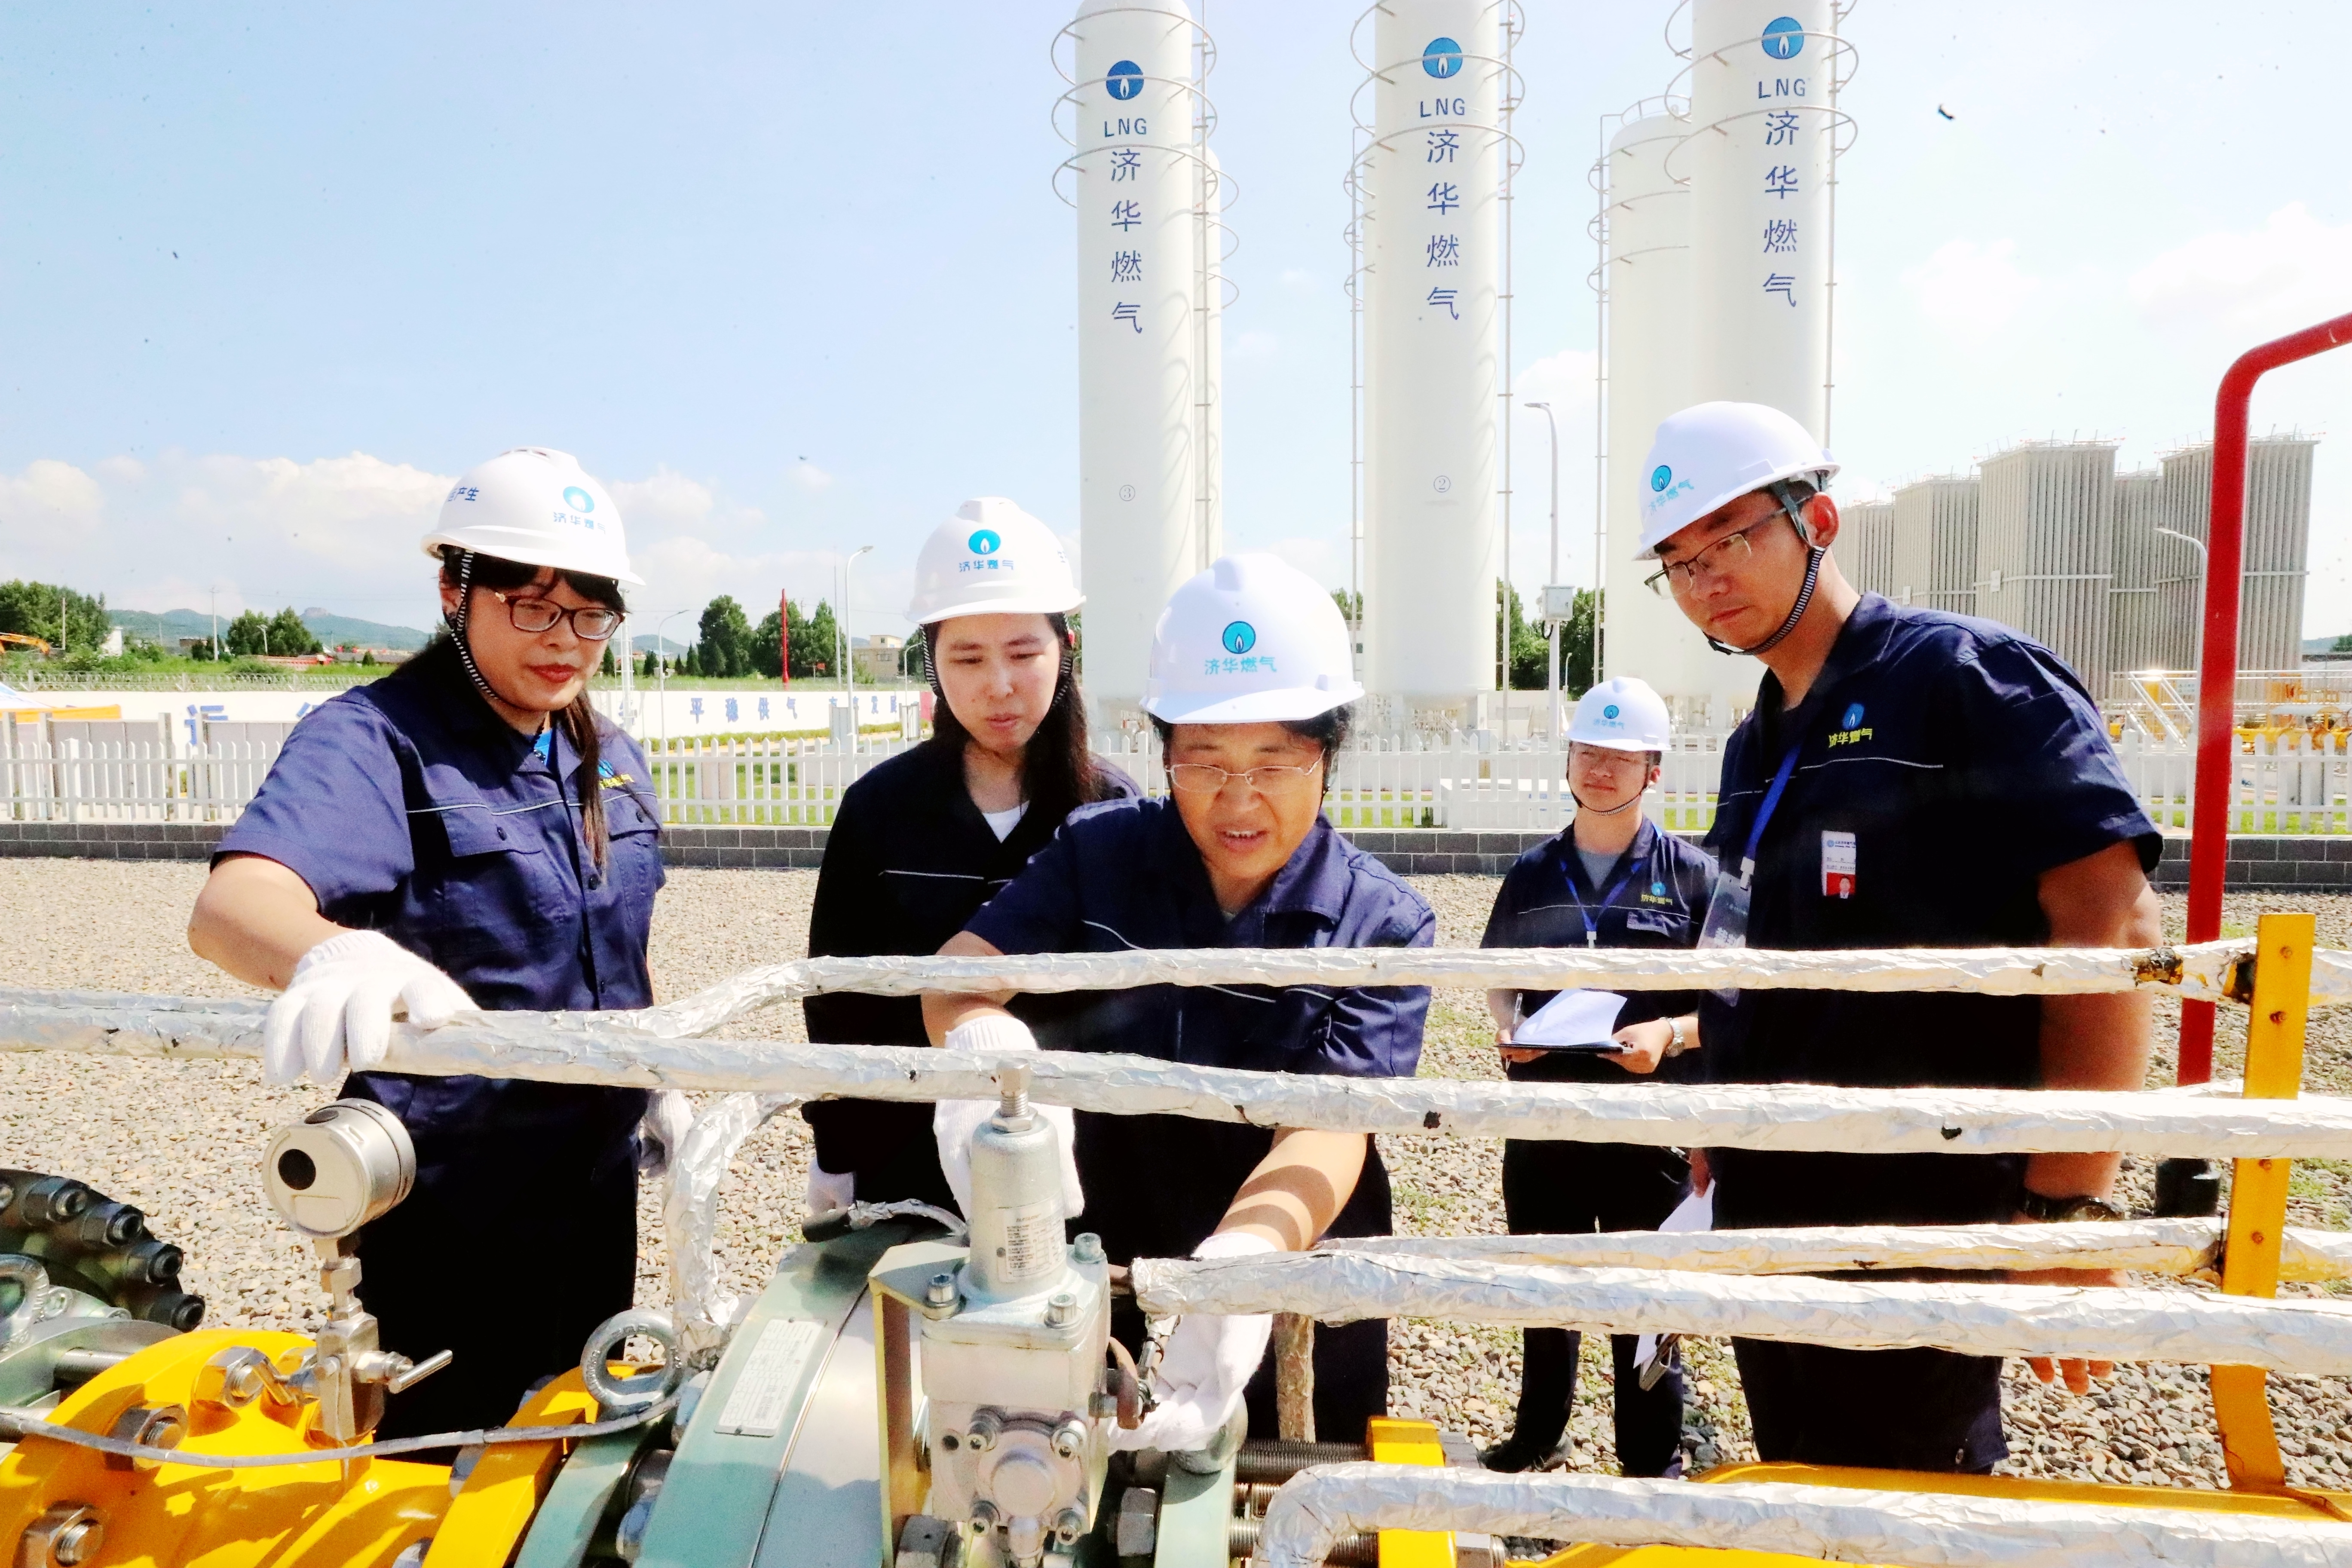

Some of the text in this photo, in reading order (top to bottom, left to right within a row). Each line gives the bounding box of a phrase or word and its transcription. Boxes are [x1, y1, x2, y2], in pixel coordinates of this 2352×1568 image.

[1758, 78, 1806, 99] LNG
[1419, 98, 1466, 119] LNG
[1104, 118, 1148, 138] LNG
[1763, 110, 1800, 308] 济华燃气
[1426, 129, 1460, 321] 济华燃气
[1110, 149, 1142, 334] 济华燃气
[959, 560, 1014, 572] 济华燃气
[1205, 656, 1277, 675] 济华燃气
[1828, 728, 1873, 748] 济华燃气
